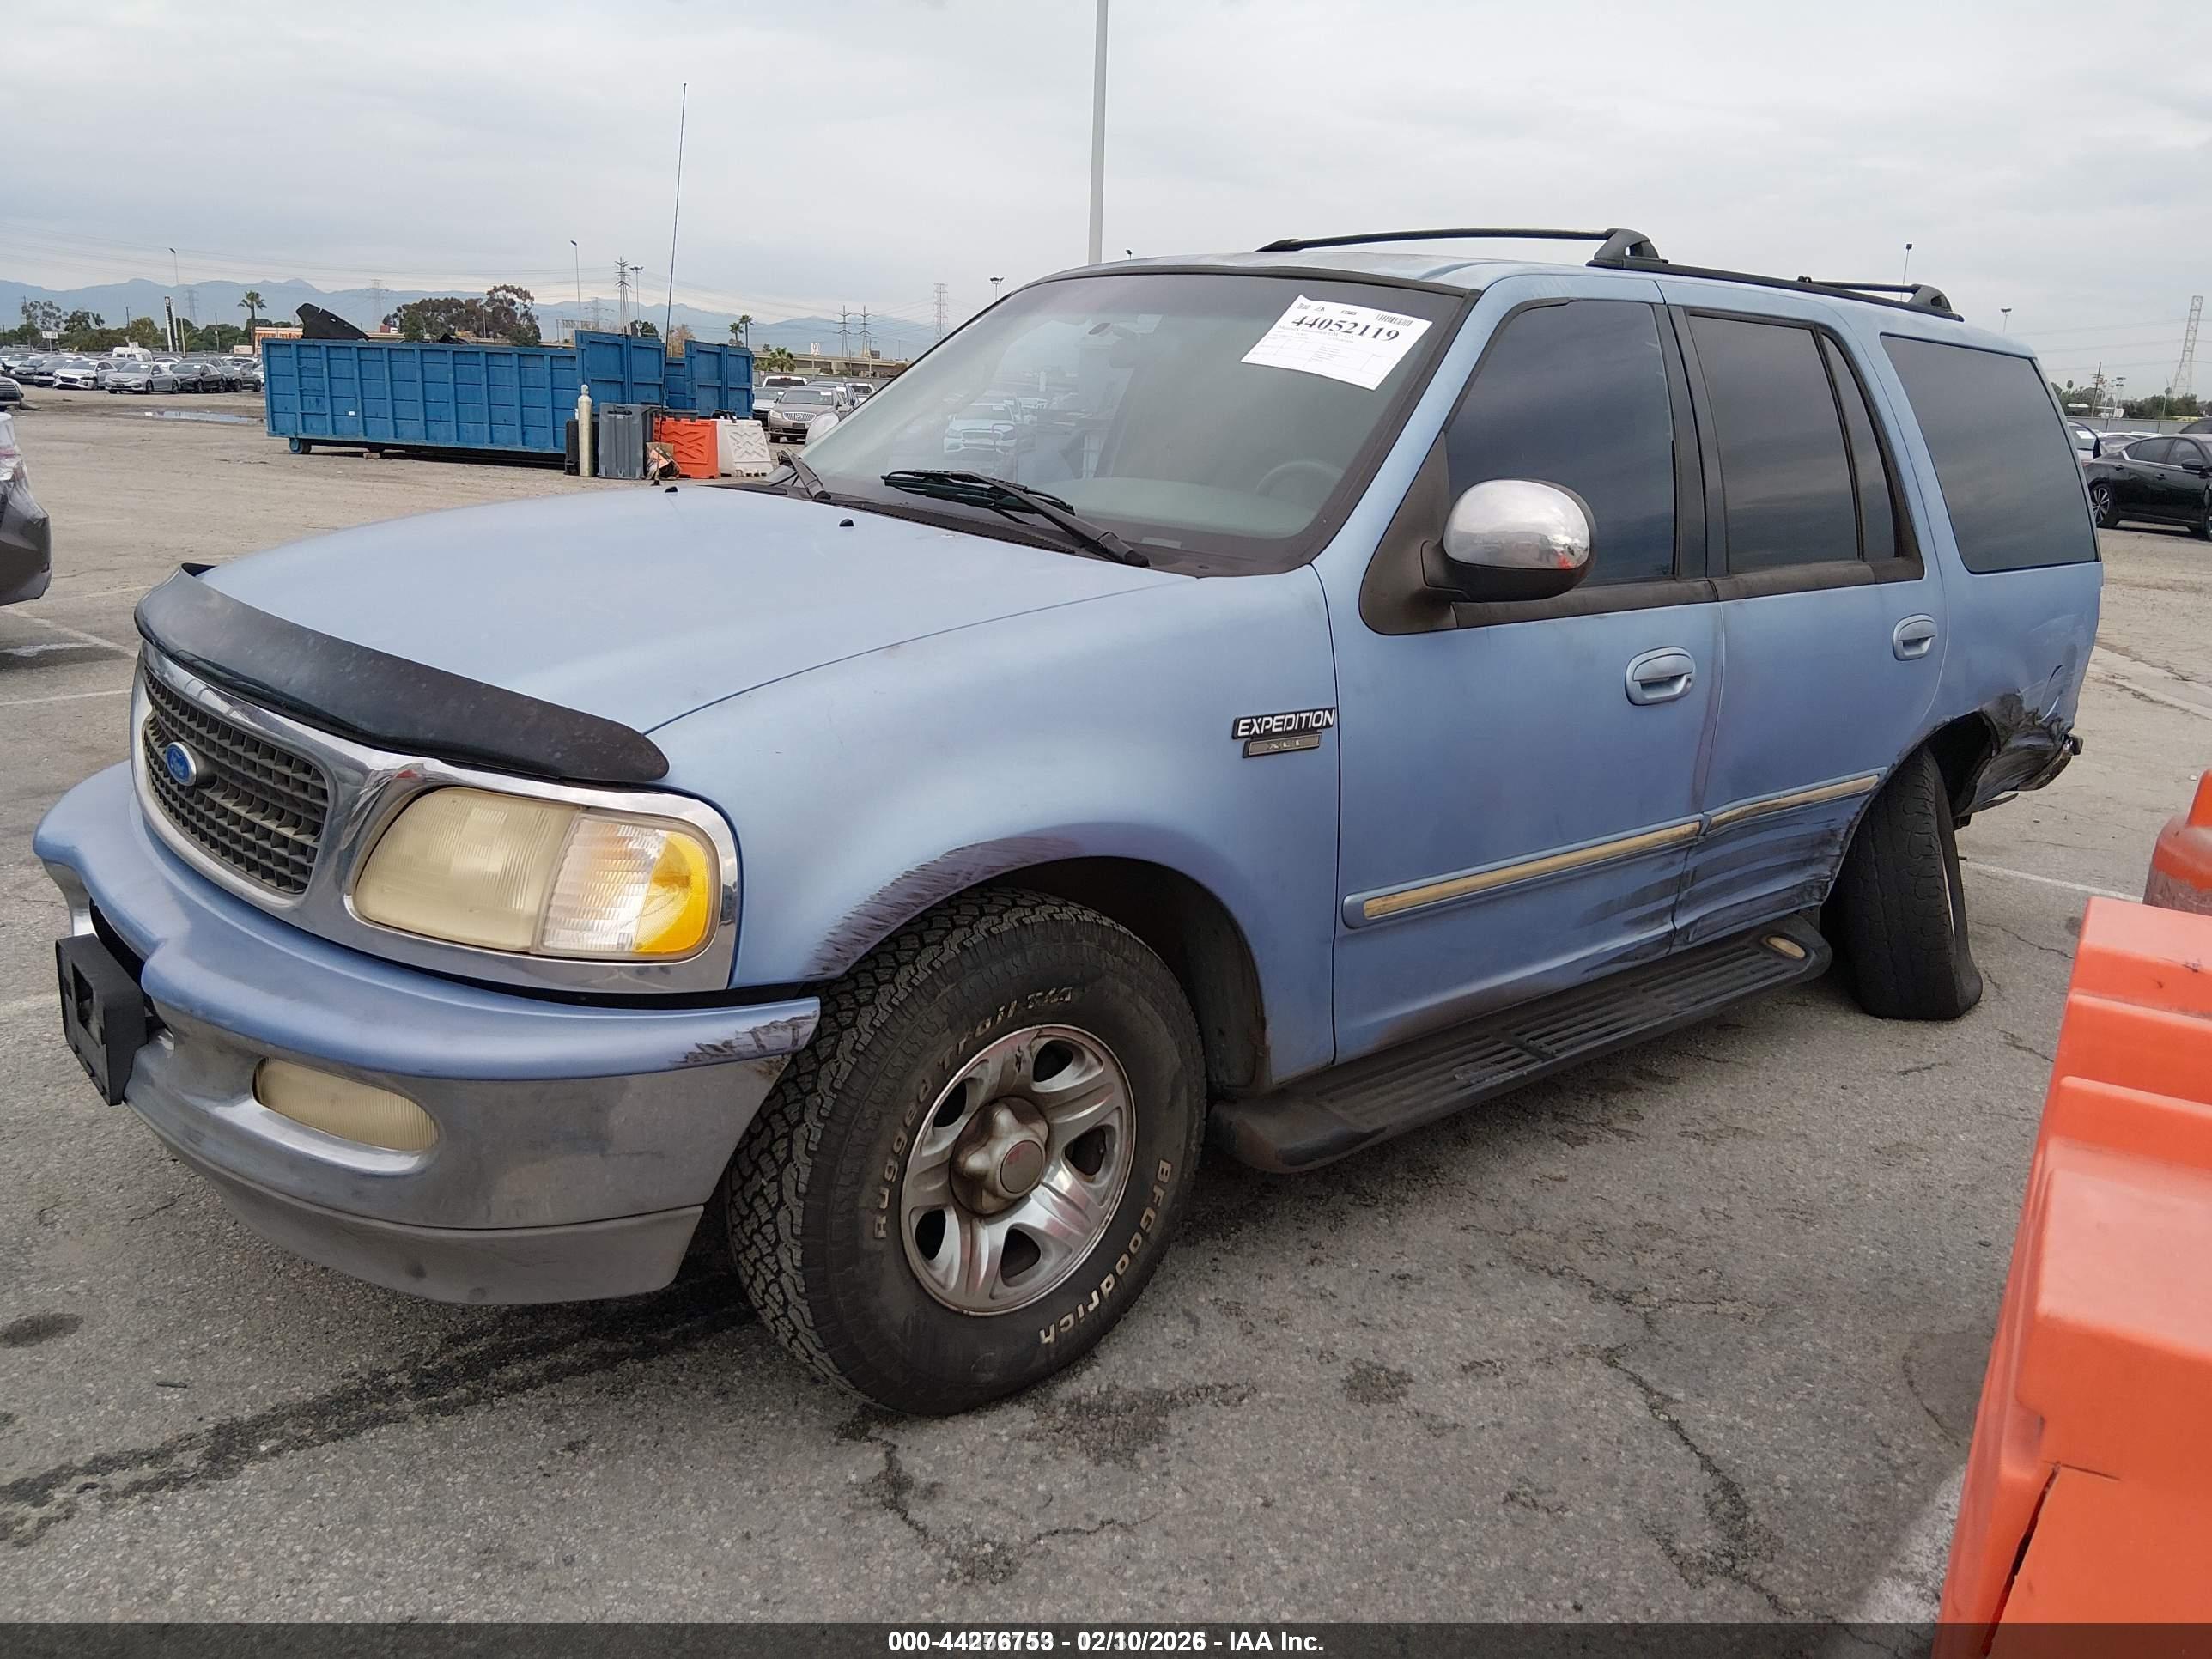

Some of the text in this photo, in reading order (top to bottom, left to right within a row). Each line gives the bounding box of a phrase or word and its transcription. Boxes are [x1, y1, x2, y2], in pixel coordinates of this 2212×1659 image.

[1291, 315, 1400, 342] 44052119
[1237, 709, 1335, 737] EXPEDITION
[874, 1077, 933, 1238] Rugged
[938, 1000, 1018, 1069] Trail
[1039, 1159, 1172, 1344] BFGoodrich
